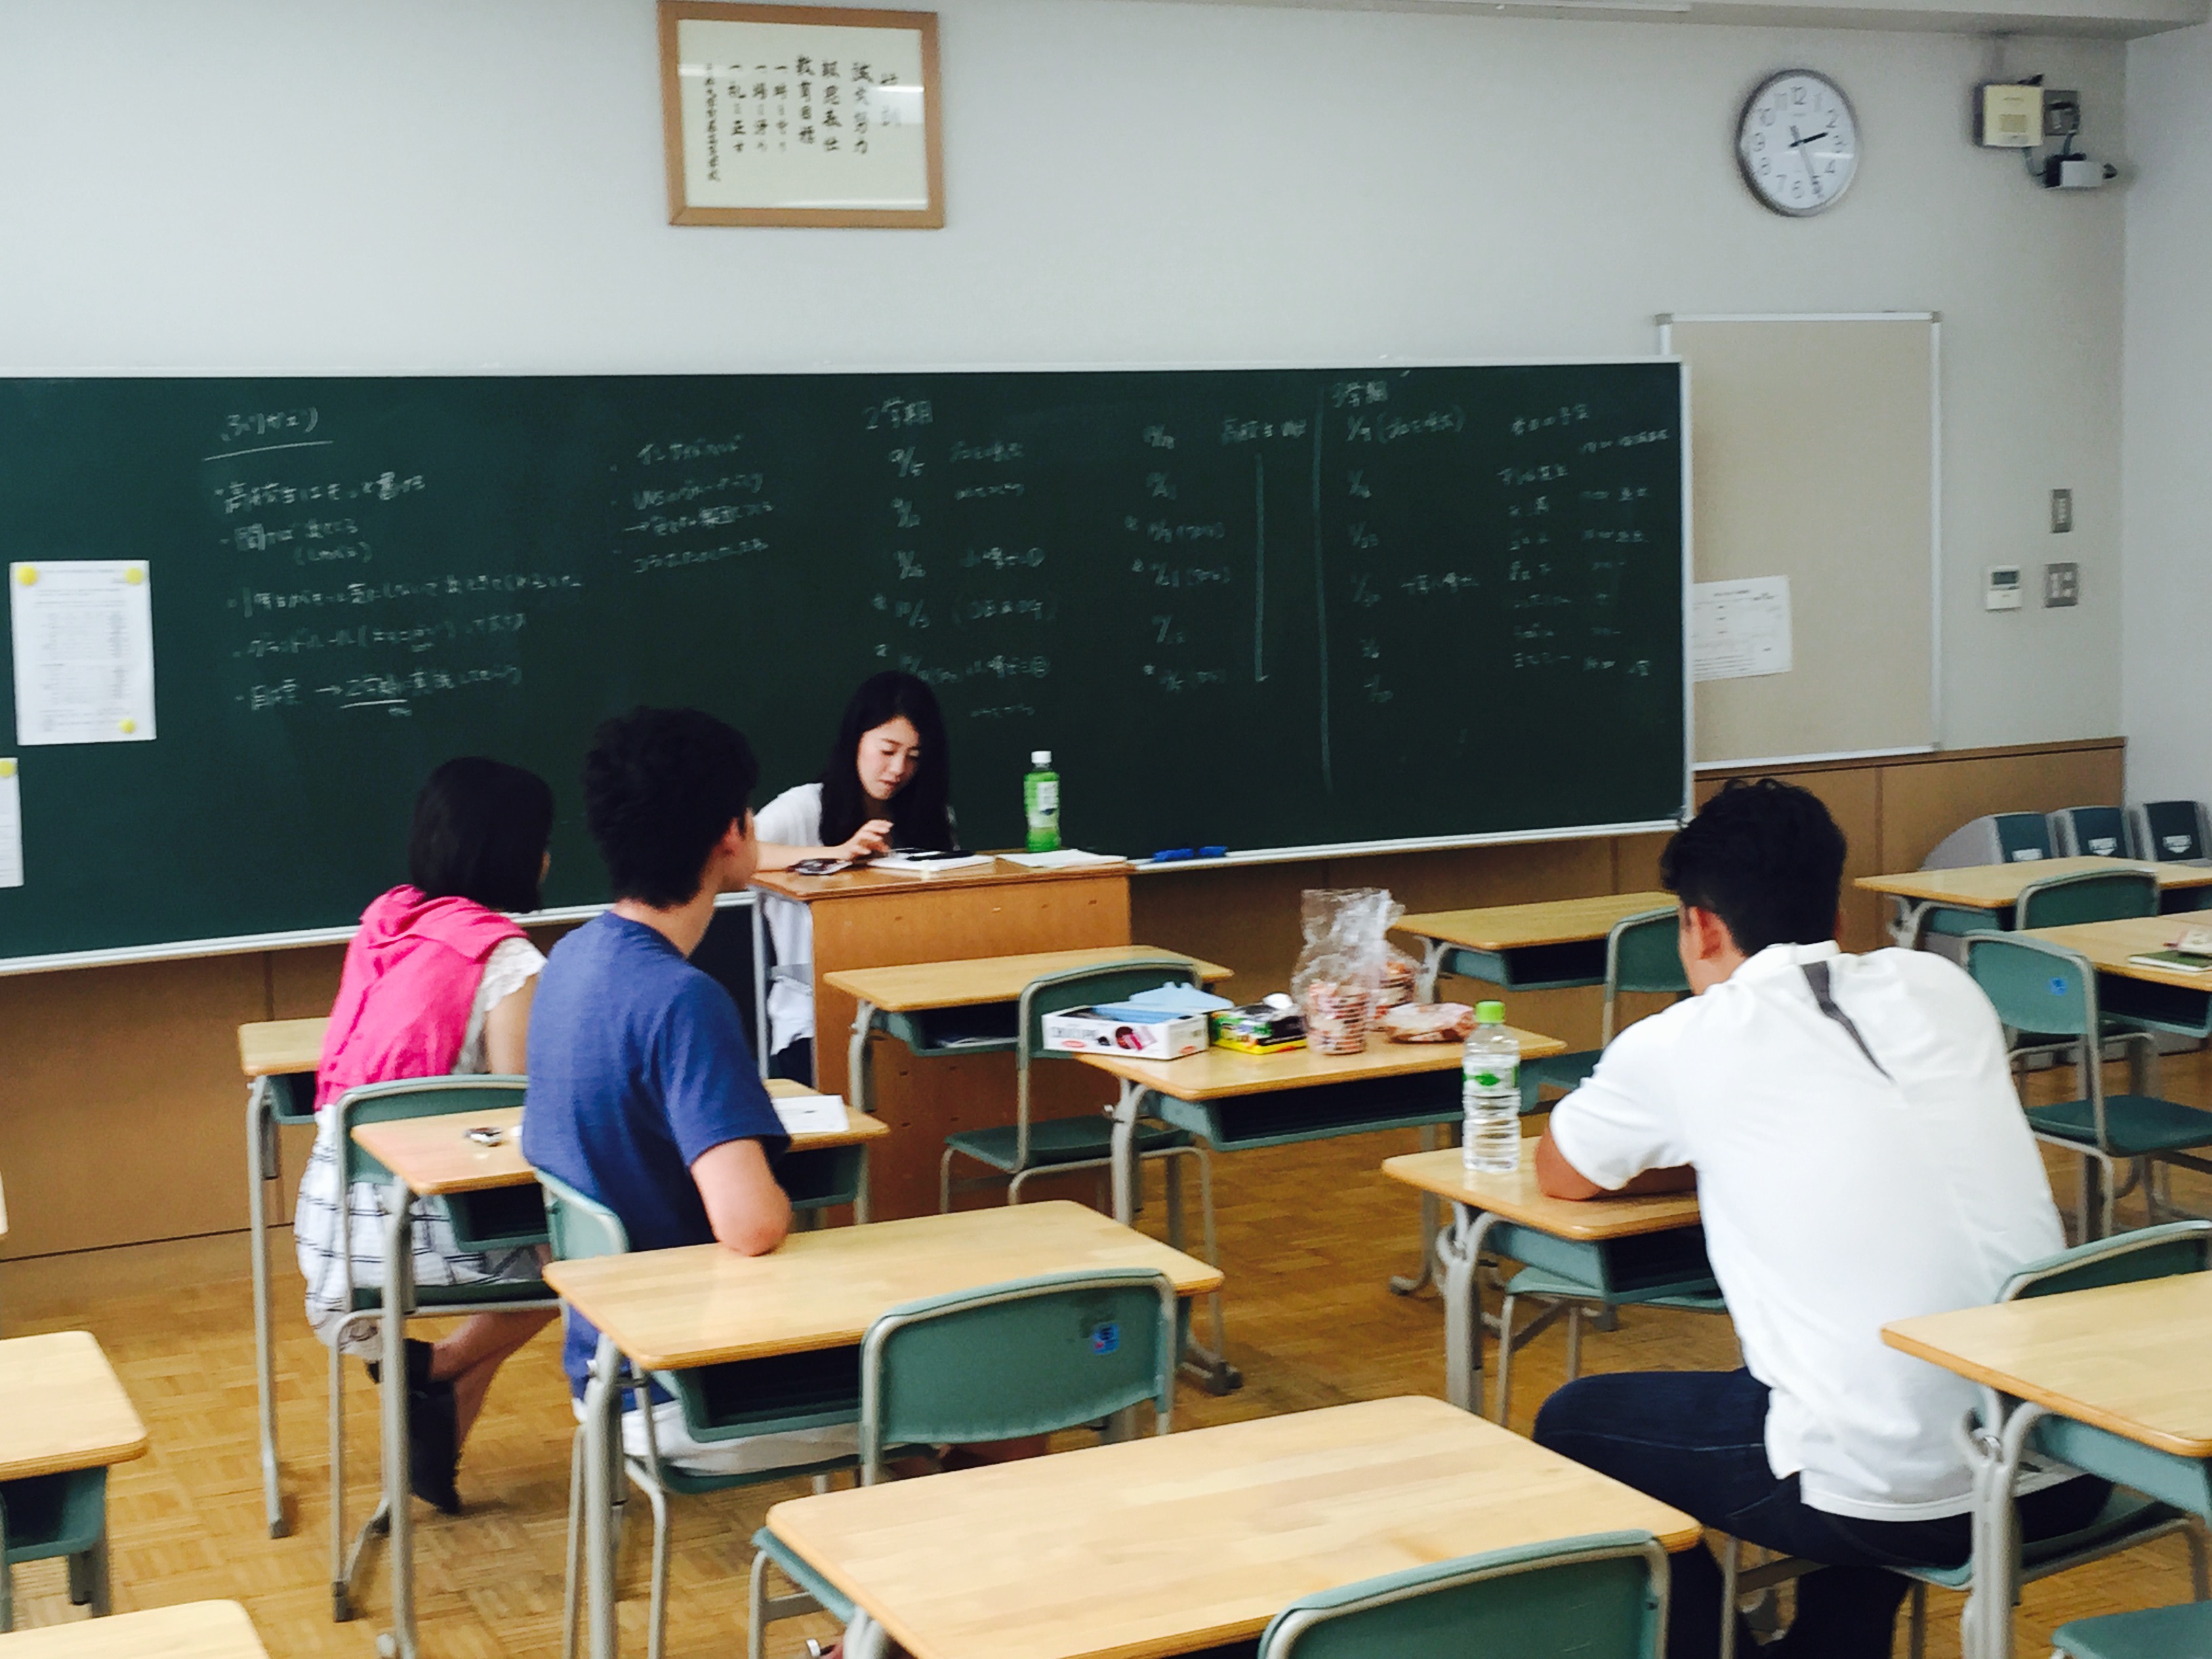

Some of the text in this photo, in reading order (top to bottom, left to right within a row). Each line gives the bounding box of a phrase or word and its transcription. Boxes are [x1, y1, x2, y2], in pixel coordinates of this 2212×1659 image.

[1791, 85, 1807, 106] 12
[1826, 108, 1840, 129] 2
[1753, 132, 1766, 152] 9
[1776, 173, 1787, 193] 7
[1792, 180, 1805, 200] 6
